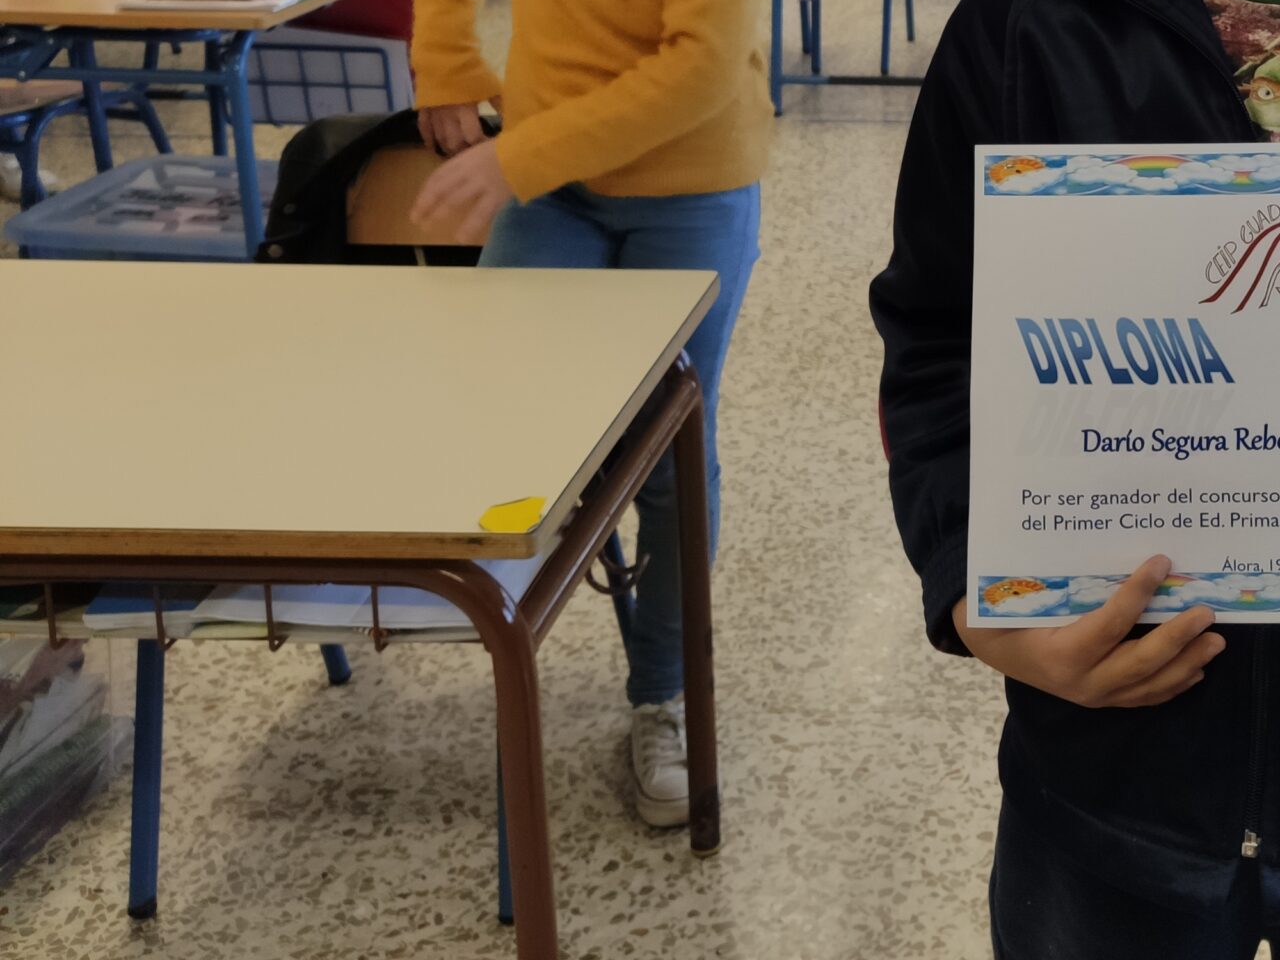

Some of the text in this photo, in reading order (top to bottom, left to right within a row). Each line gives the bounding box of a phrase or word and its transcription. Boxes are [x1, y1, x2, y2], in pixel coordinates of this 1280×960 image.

[1015, 317, 1236, 385] DIPLOMA
[1081, 428, 1145, 452] Darío
[1151, 428, 1228, 460] Segura
[1022, 489, 1051, 505] Por
[1058, 494, 1084, 505] ser
[1090, 489, 1161, 510] ganador
[1167, 488, 1192, 504] del
[1199, 491, 1280, 504] concurso
[1021, 515, 1046, 530] del
[1054, 515, 1113, 531] Primer
[1119, 513, 1165, 529] Ciclo
[1172, 513, 1193, 528] de
[1199, 512, 1225, 528] Ed.
[1221, 556, 1265, 573] Álora,
